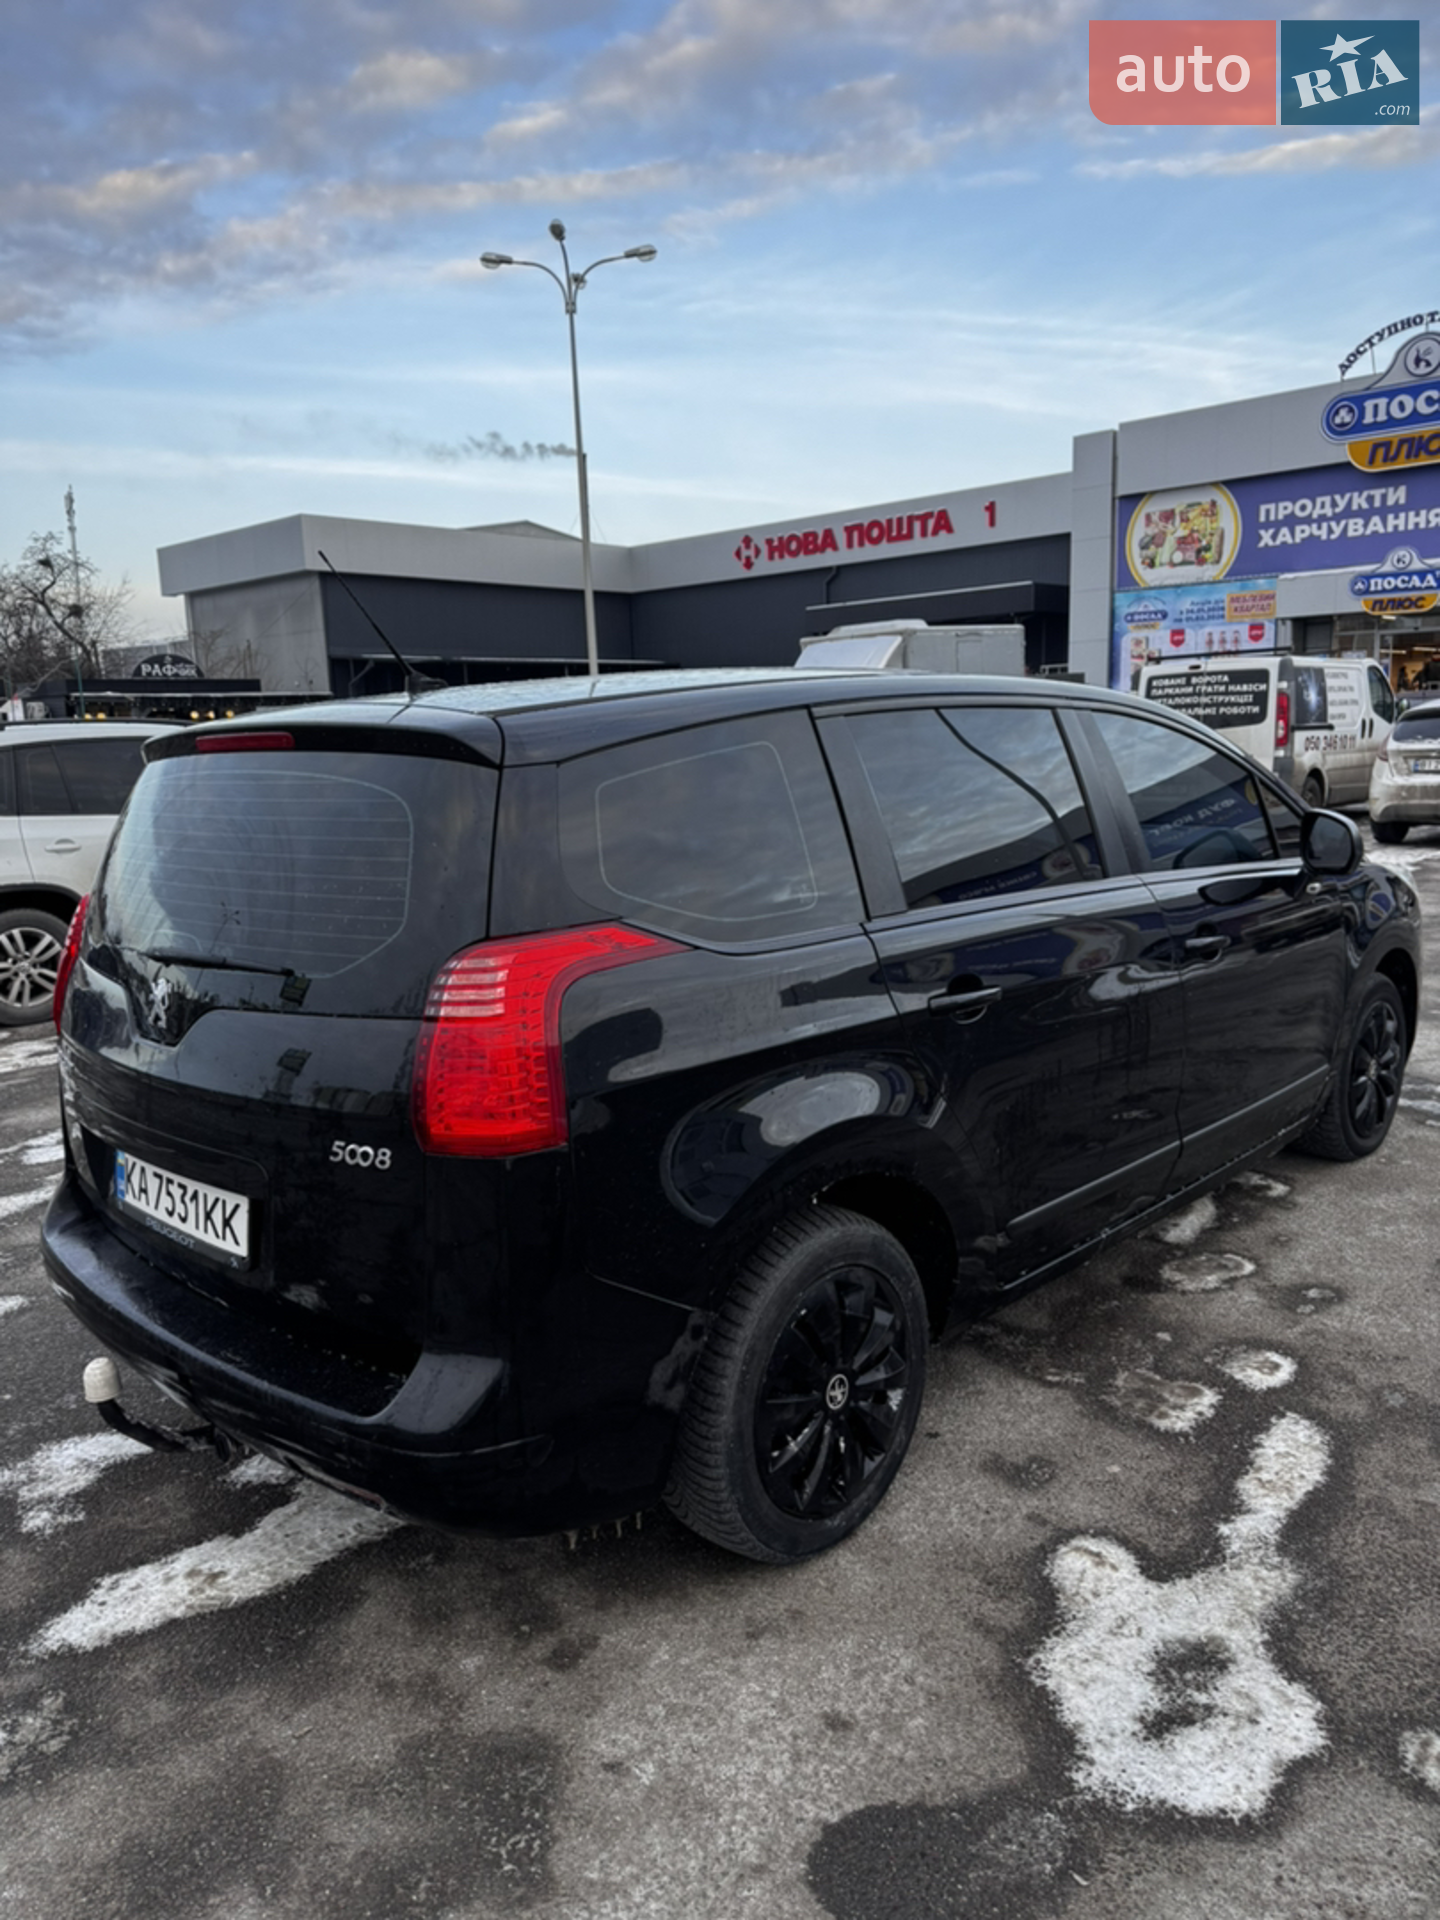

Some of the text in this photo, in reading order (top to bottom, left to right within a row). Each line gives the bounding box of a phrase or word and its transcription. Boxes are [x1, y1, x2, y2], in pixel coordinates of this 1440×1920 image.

[1338, 310, 1440, 377] ДОСТУПНО Т
[1361, 389, 1440, 425] ПОС
[1258, 484, 1407, 523] ПРОДУКТИ
[764, 501, 997, 562] НОВА ПОШТА 1
[1257, 507, 1440, 548] ХАРЧУВАННЯ
[1369, 573, 1437, 591] ПОСАД
[1371, 596, 1426, 612] ПЛЮС
[1150, 682, 1268, 696] ПАРКАНИ ГРАТИ НАВІСИ
[1151, 674, 1230, 687] КОВАНІ ВОРОТА
[1218, 705, 1260, 715] РОБОТИ
[1304, 735, 1321, 752] 050
[329, 1140, 392, 1170] 5008
[145, 1217, 196, 1249] PEUGEOT
